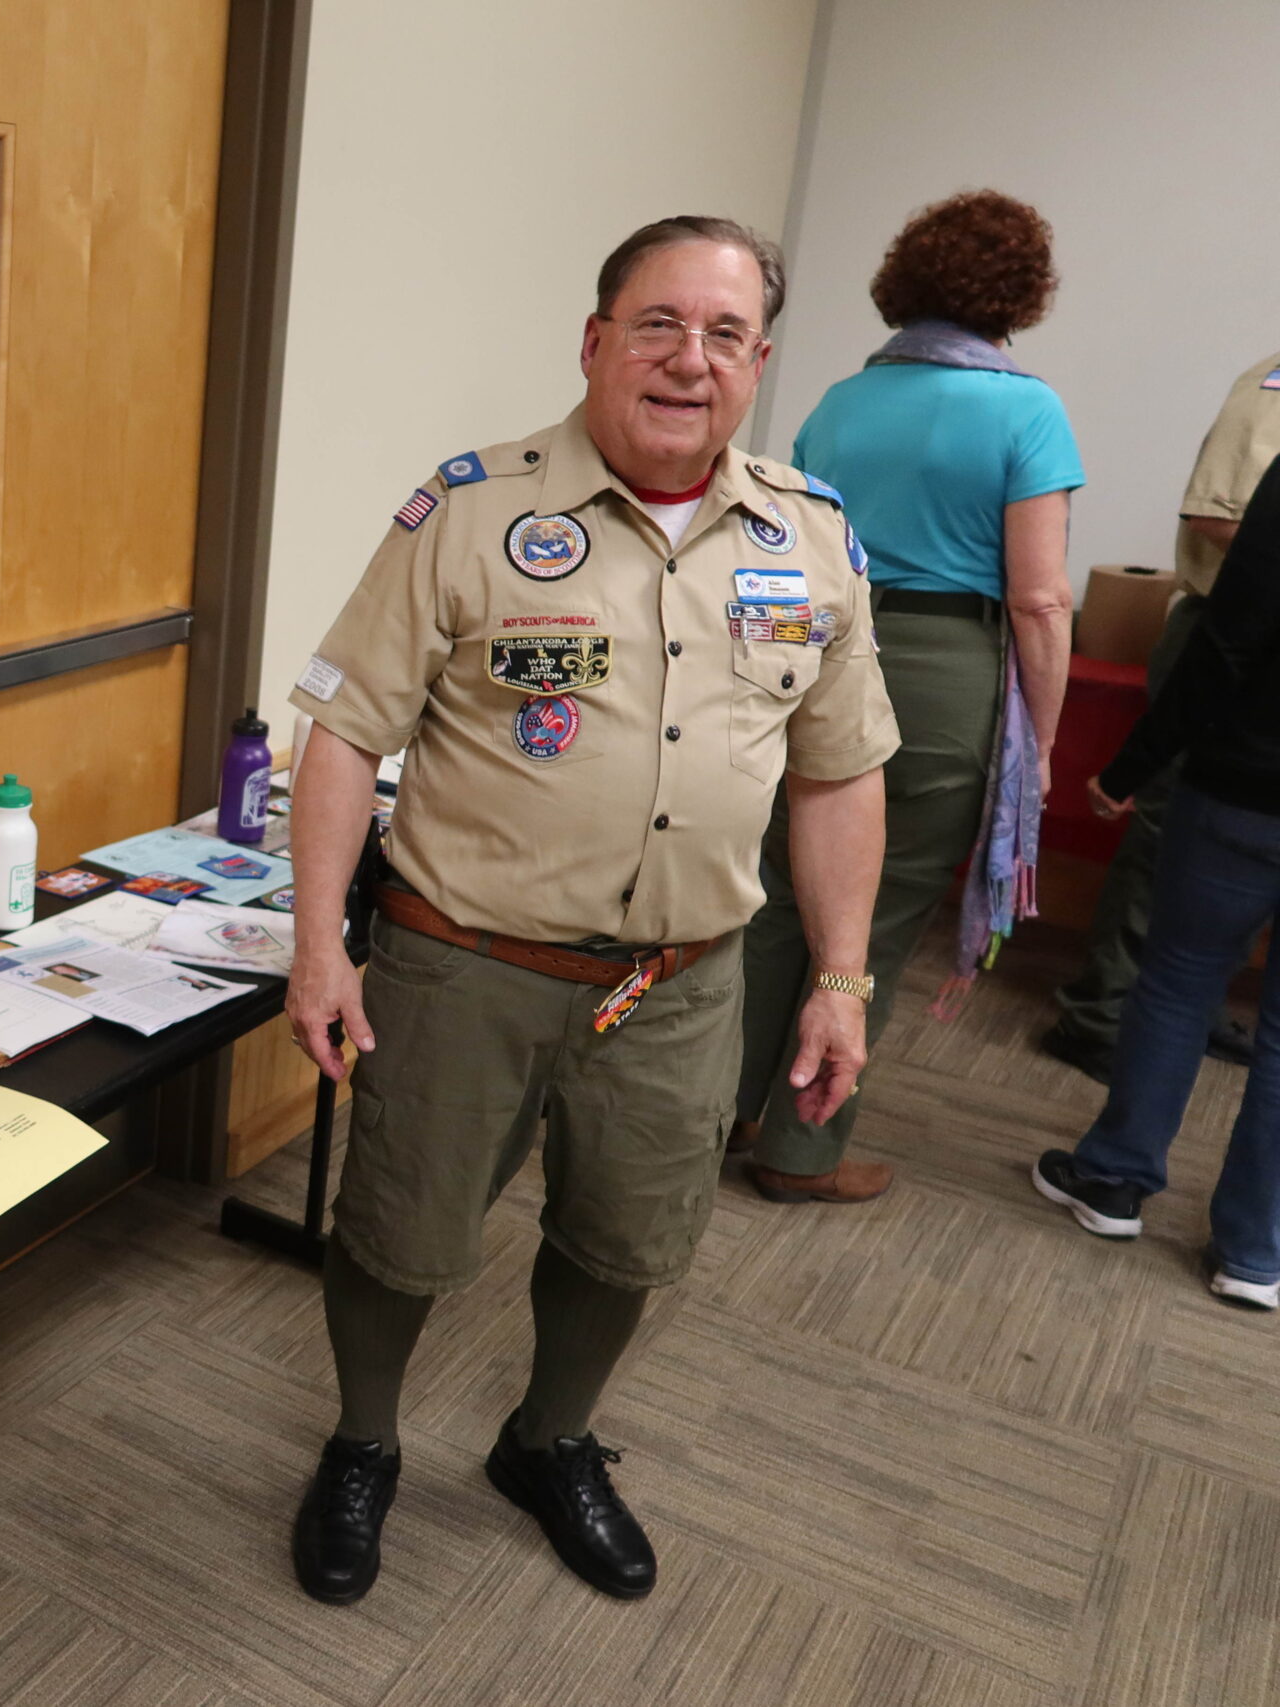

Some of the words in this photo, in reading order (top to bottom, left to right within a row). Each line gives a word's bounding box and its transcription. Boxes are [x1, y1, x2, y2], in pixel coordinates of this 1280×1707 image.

[521, 560, 542, 575] YEARS
[553, 549, 584, 576] SCOUTING
[503, 617, 520, 628] BOY
[520, 616, 552, 627] SCOUTS
[560, 616, 596, 626] AMERICA
[493, 638, 568, 647] CHILANTAKOBA
[527, 658, 556, 666] WHO
[531, 665, 553, 673] DAT
[520, 673, 563, 681] NATION
[507, 678, 543, 691] LOUISIANA
[532, 748, 548, 756] USA
